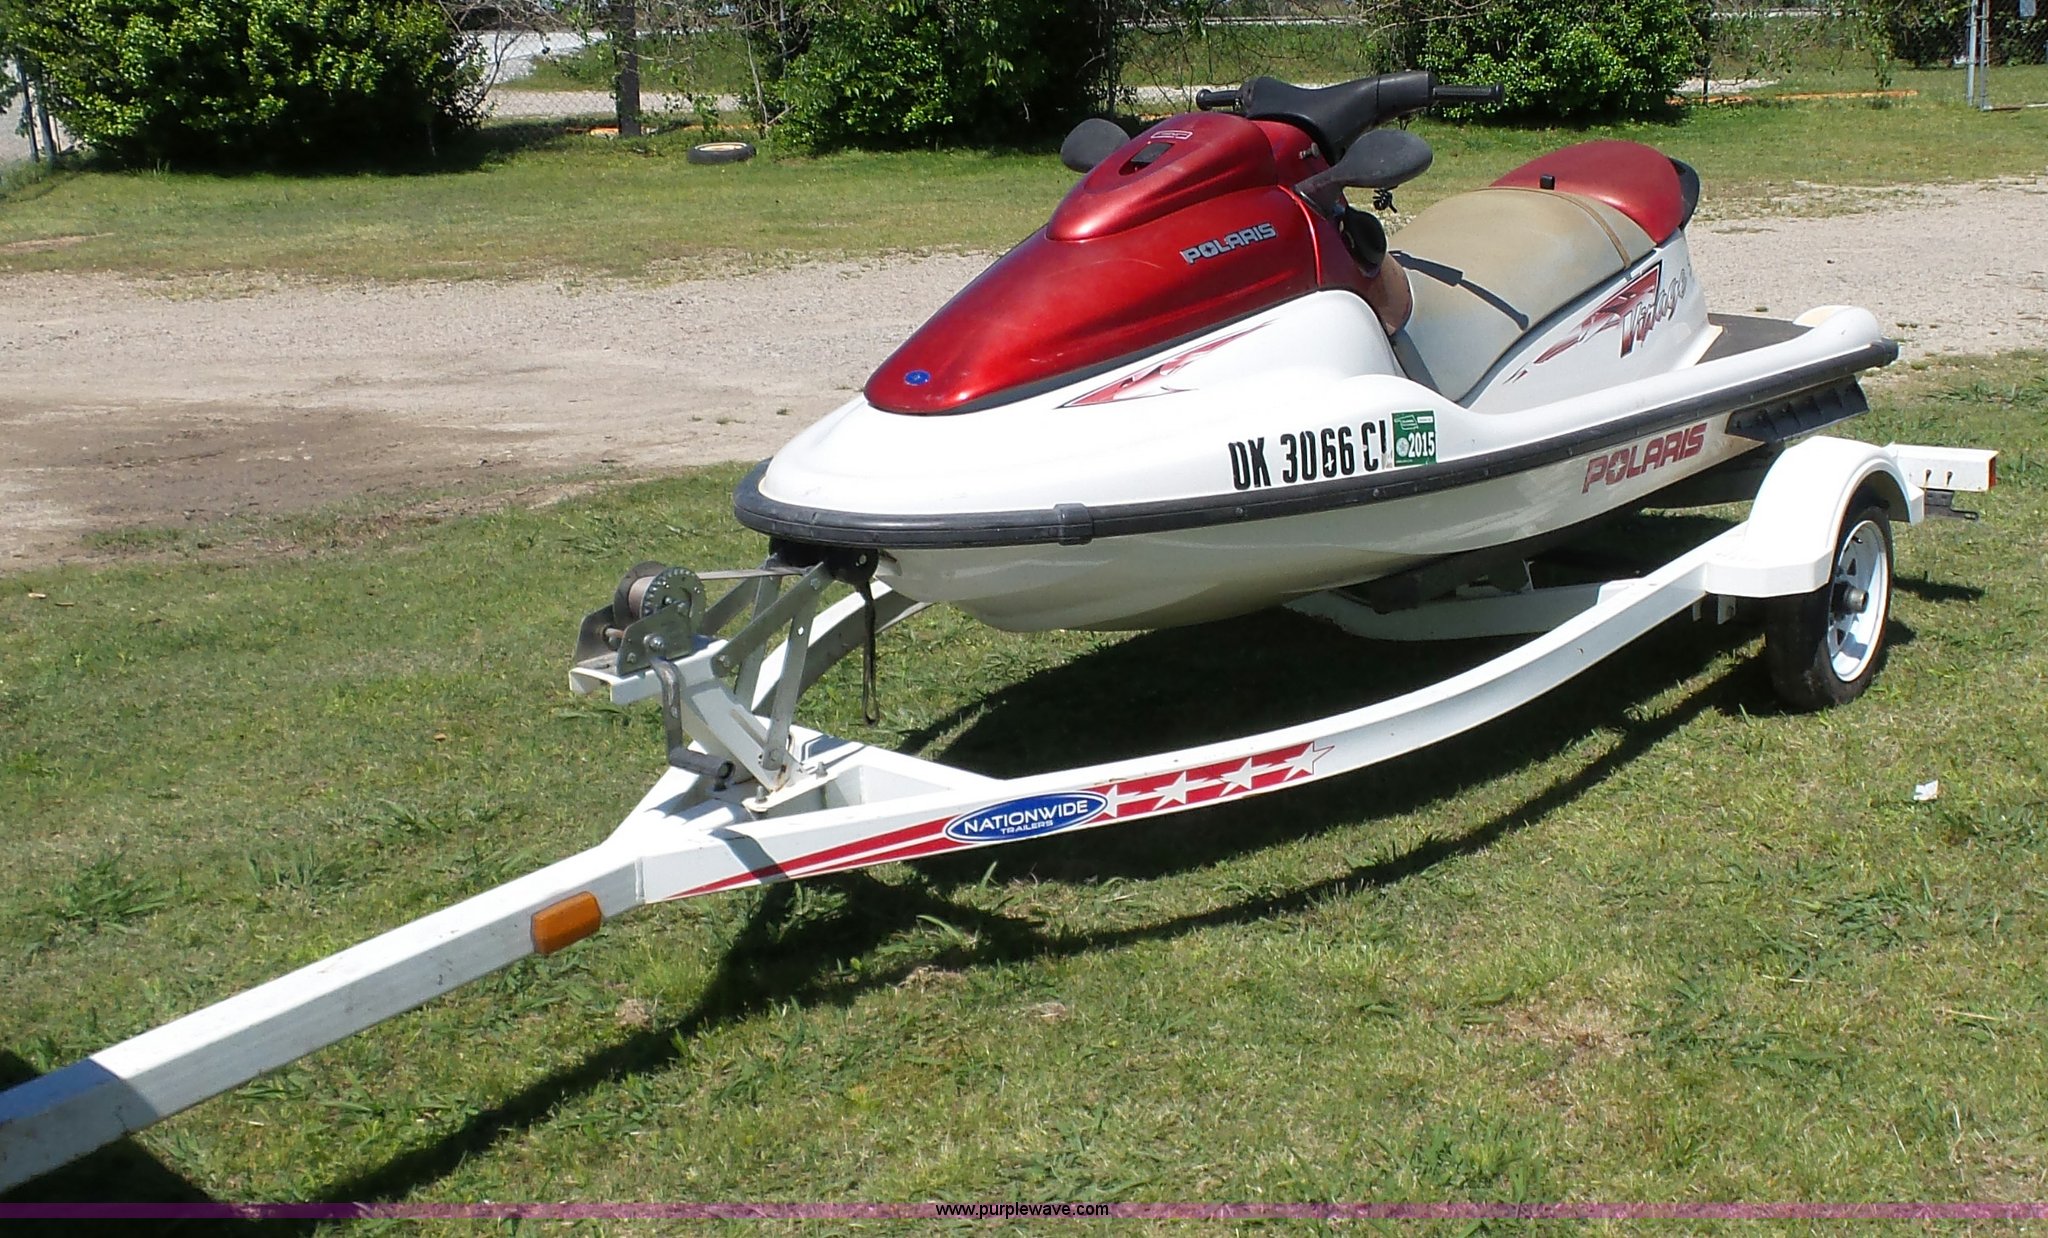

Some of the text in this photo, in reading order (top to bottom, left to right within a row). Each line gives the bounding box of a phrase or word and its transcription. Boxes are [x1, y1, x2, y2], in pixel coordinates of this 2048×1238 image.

[1179, 222, 1277, 265] POLARIS
[1280, 426, 1355, 484] 3066
[1408, 431, 1435, 458] 2015
[1581, 422, 1708, 494] POLARIS
[964, 800, 1089, 835] NATIONWIDE
[1001, 820, 1053, 835] TRAILERS
